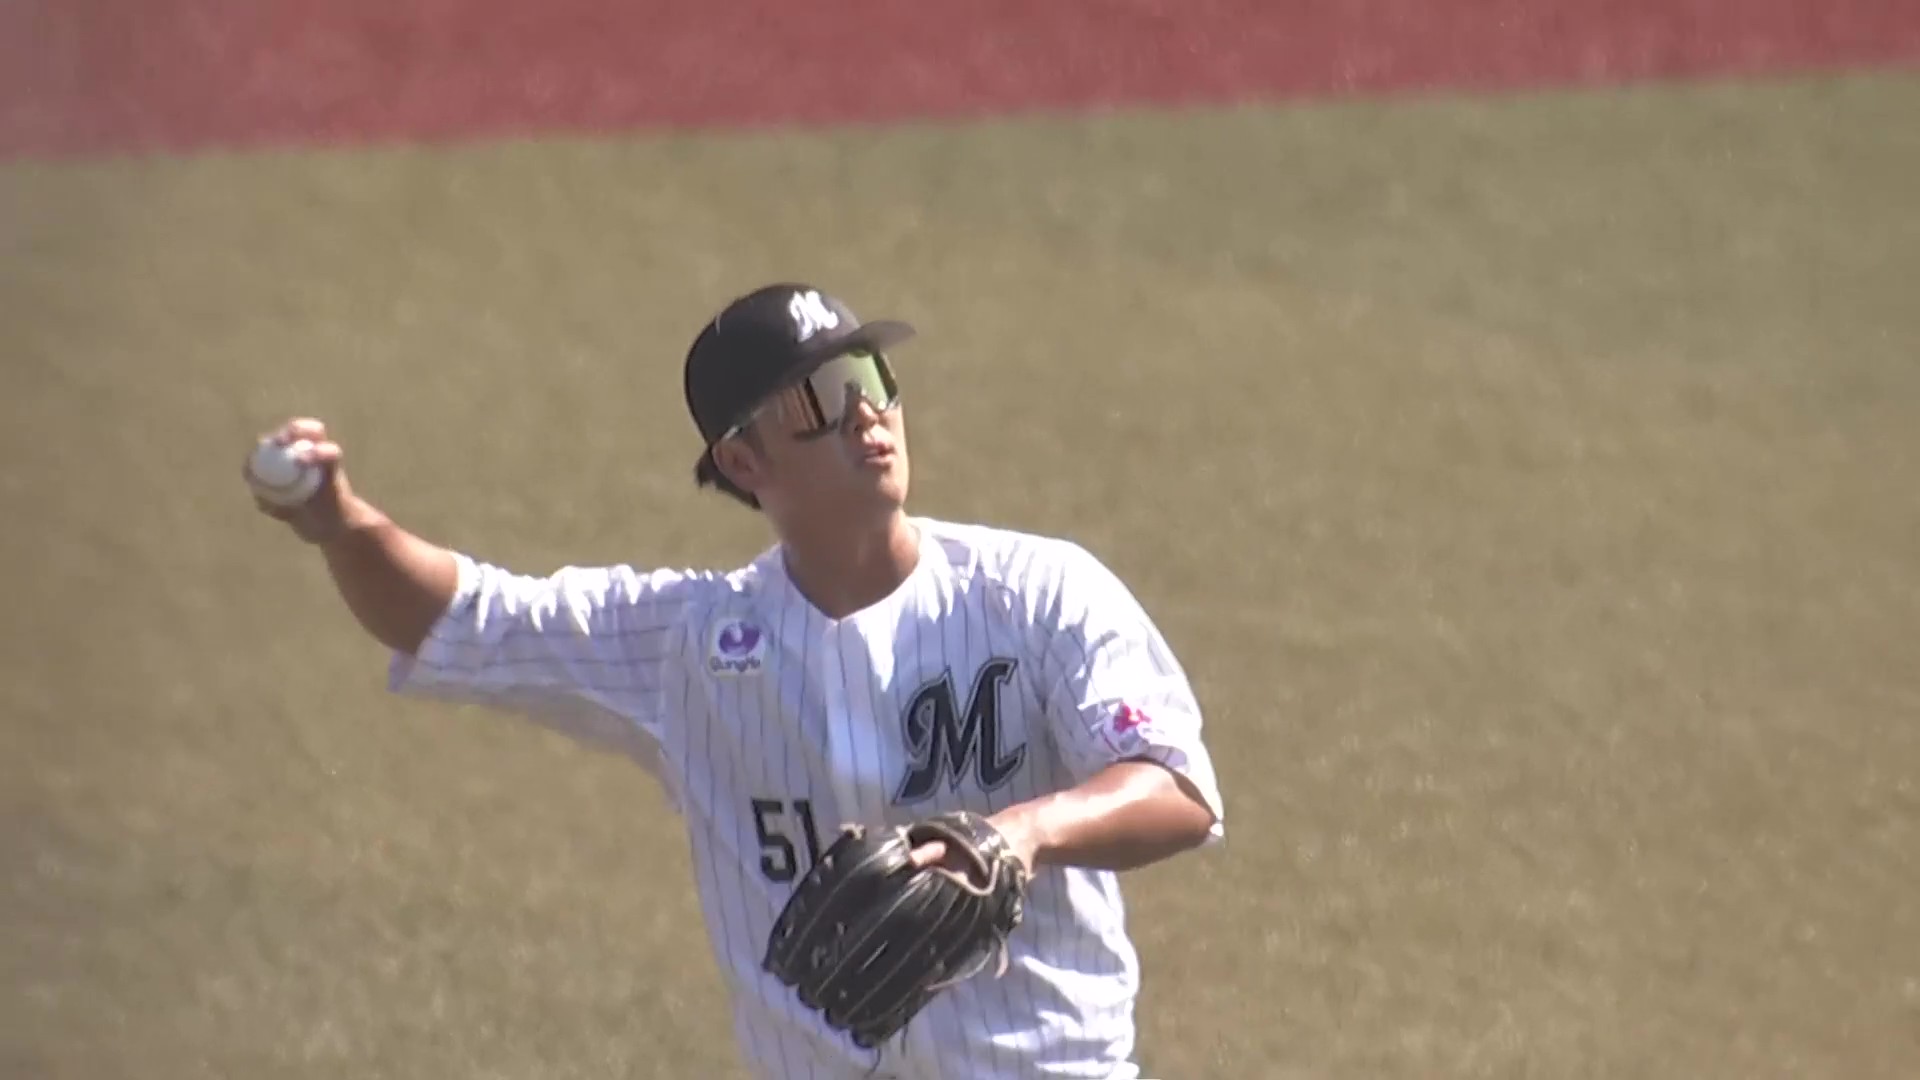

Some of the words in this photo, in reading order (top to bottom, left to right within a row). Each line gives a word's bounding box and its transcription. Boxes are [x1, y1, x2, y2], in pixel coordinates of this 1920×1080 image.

[789, 290, 839, 342] M
[892, 657, 1026, 805] M
[751, 798, 822, 883] 51
